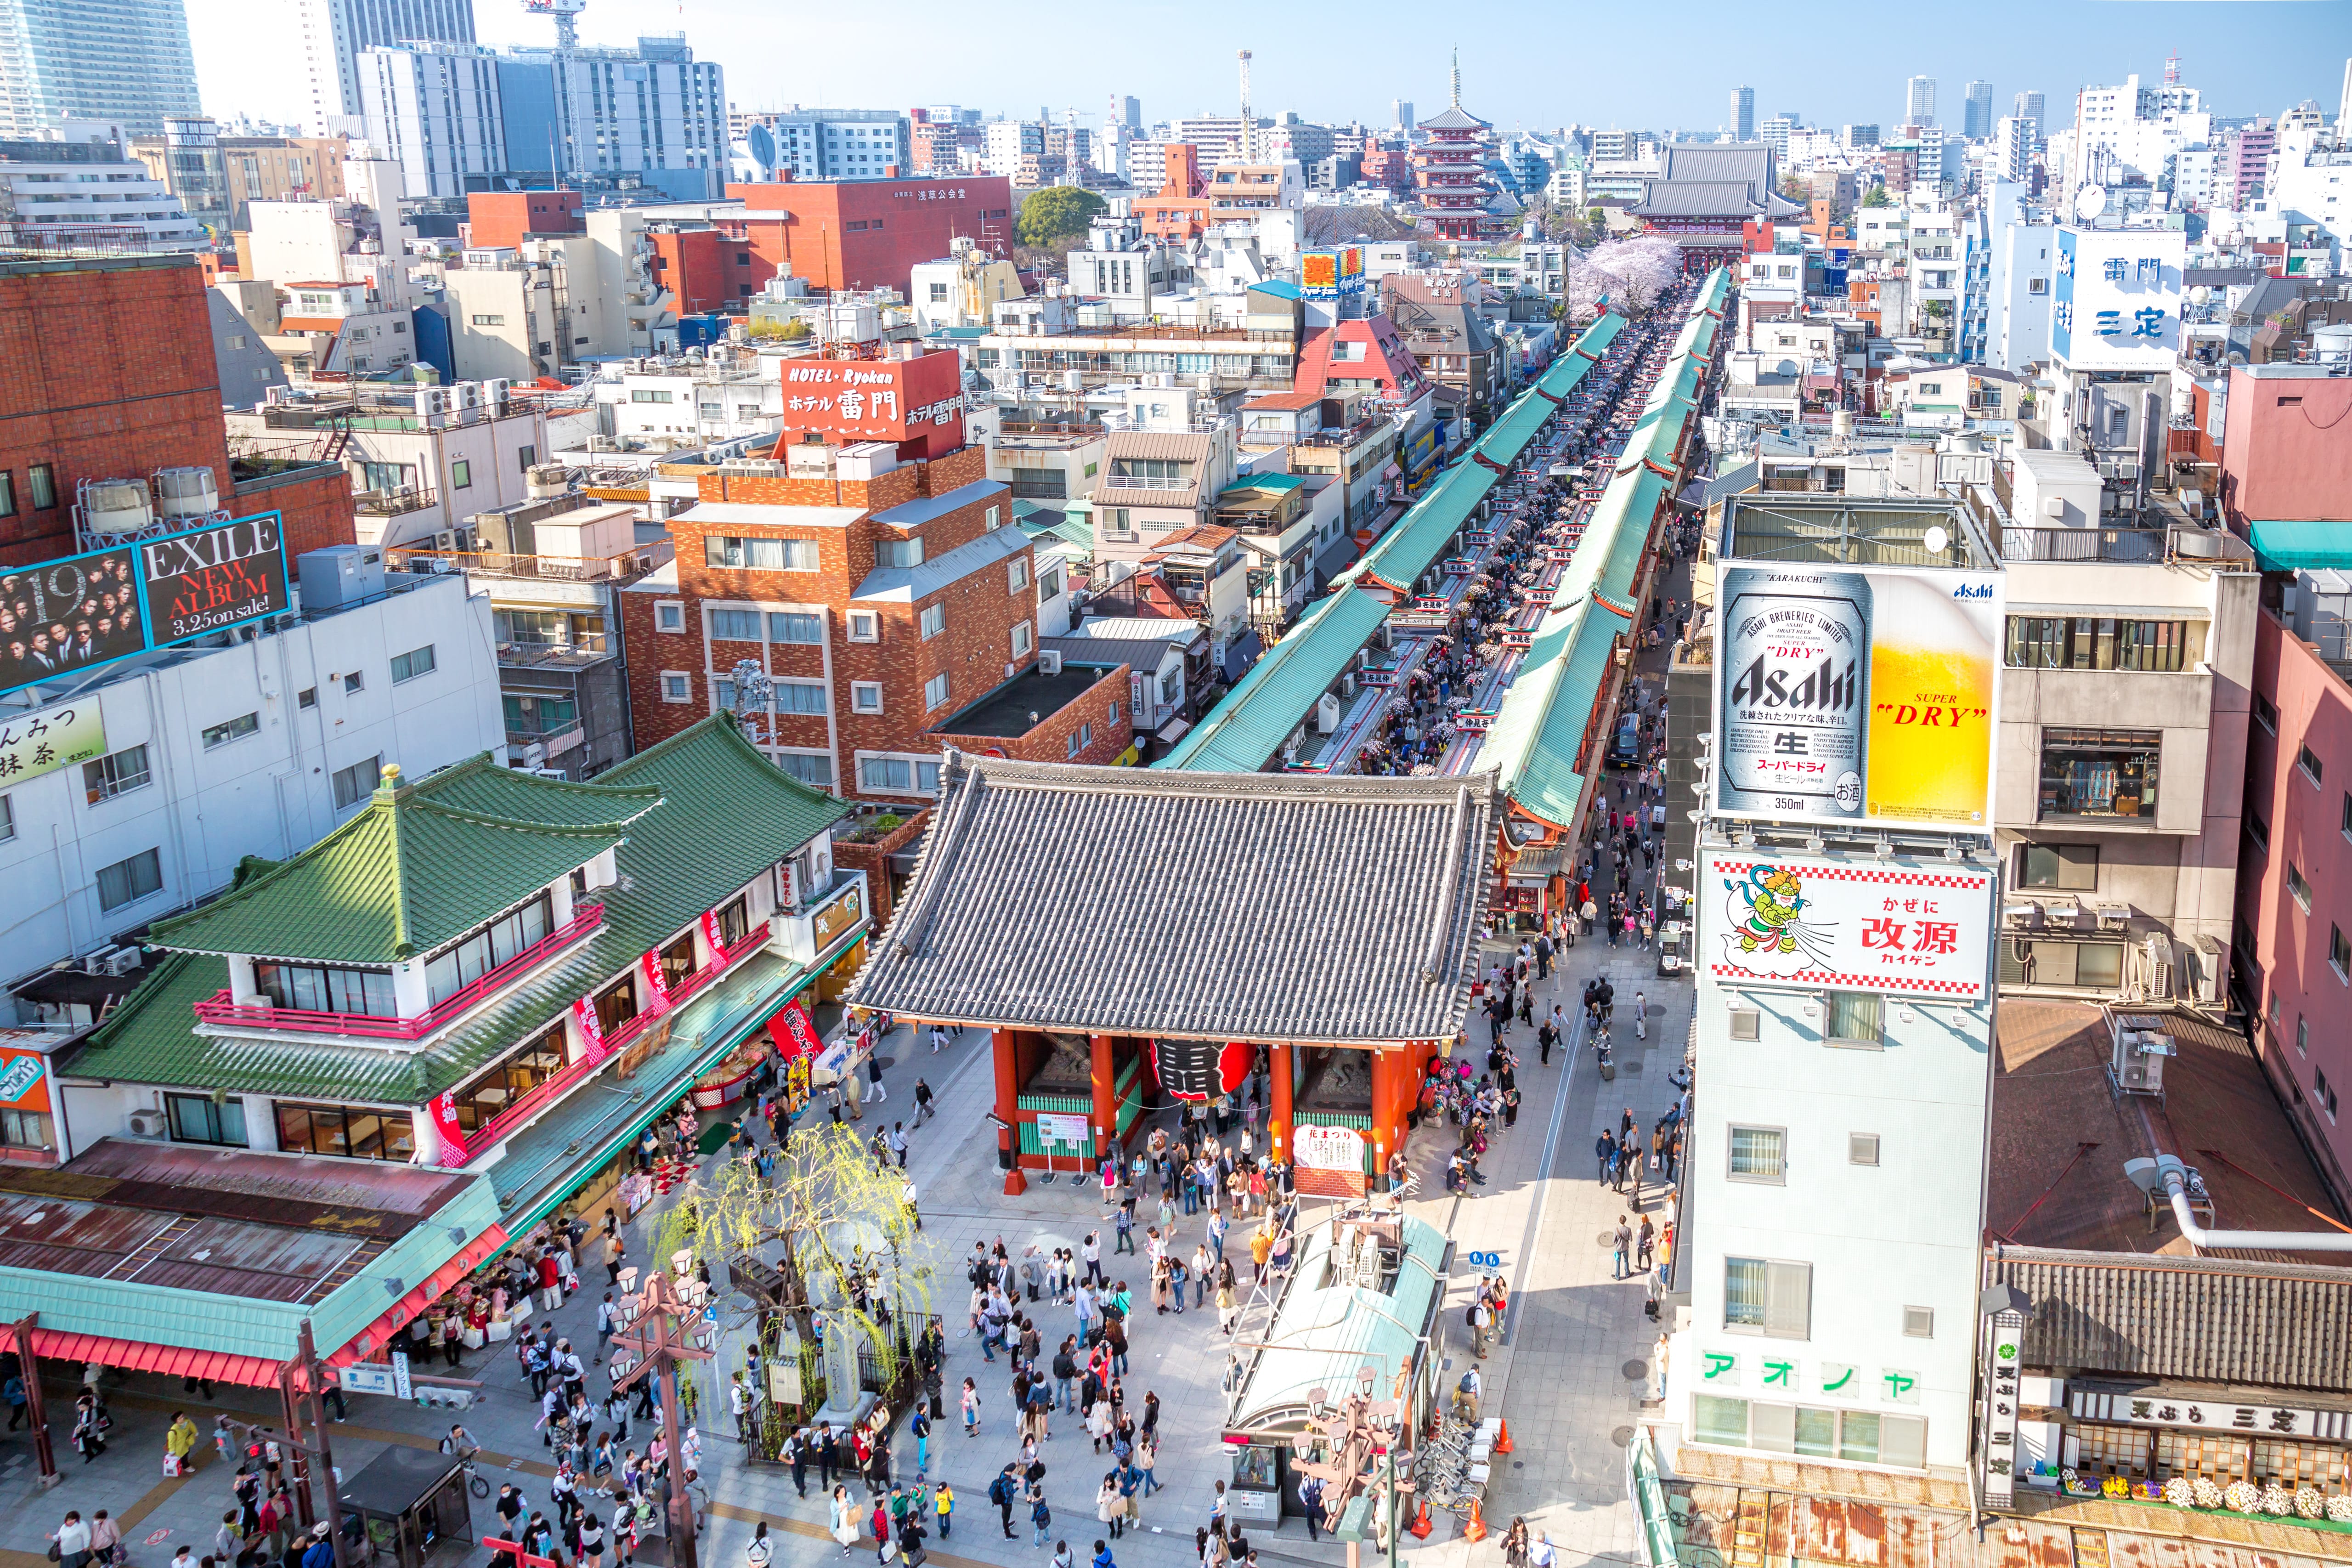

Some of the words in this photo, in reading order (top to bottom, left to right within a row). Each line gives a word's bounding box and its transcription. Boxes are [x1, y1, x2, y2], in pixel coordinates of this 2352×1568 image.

[918, 188, 966, 201] 浅草公会堂
[1303, 255, 1335, 284] 薬
[1347, 248, 1358, 274] 薬
[2103, 257, 2161, 282] 雷門
[2092, 306, 2165, 339] 三定
[789, 368, 833, 383] HOTEL
[843, 369, 893, 386] Ryokan
[789, 389, 898, 422] ホテル雷門
[905, 392, 963, 426] ホテル雷門
[142, 518, 279, 583] EXILE
[181, 558, 249, 595] NEW
[24, 564, 86, 627] 19
[169, 574, 269, 619] ALBUM
[1954, 583, 1993, 598] Asahi
[236, 595, 270, 619] sale!
[1747, 617, 1767, 639] ASAHI
[1769, 611, 1815, 624] BREWERIES
[1818, 617, 1843, 643] LIMITED
[1731, 652, 1856, 713] Asahi
[1914, 693, 1957, 704] SUPER
[1740, 710, 1847, 725] 洗練されたクリアな味、辛口。
[1774, 732, 1809, 755] 生
[1758, 759, 1826, 773] スーパードライ
[1775, 774, 1805, 784] 生ビール
[1775, 798, 1804, 810] 350ml
[1838, 783, 1860, 802] お酒
[1883, 897, 1938, 913] かぜに
[1862, 917, 1958, 954] 改源
[1882, 953, 1936, 966] カイゲン
[441, 1088, 457, 1124] 丼物
[1309, 1129, 1351, 1140] 花まつり
[1705, 1353, 1914, 1398] アオノヤ
[1996, 1366, 2017, 1416] 天ぷら
[2130, 1400, 2206, 1423] 天ぷら
[2232, 1408, 2296, 1433] 三定
[1989, 1431, 2013, 1476] 三定
